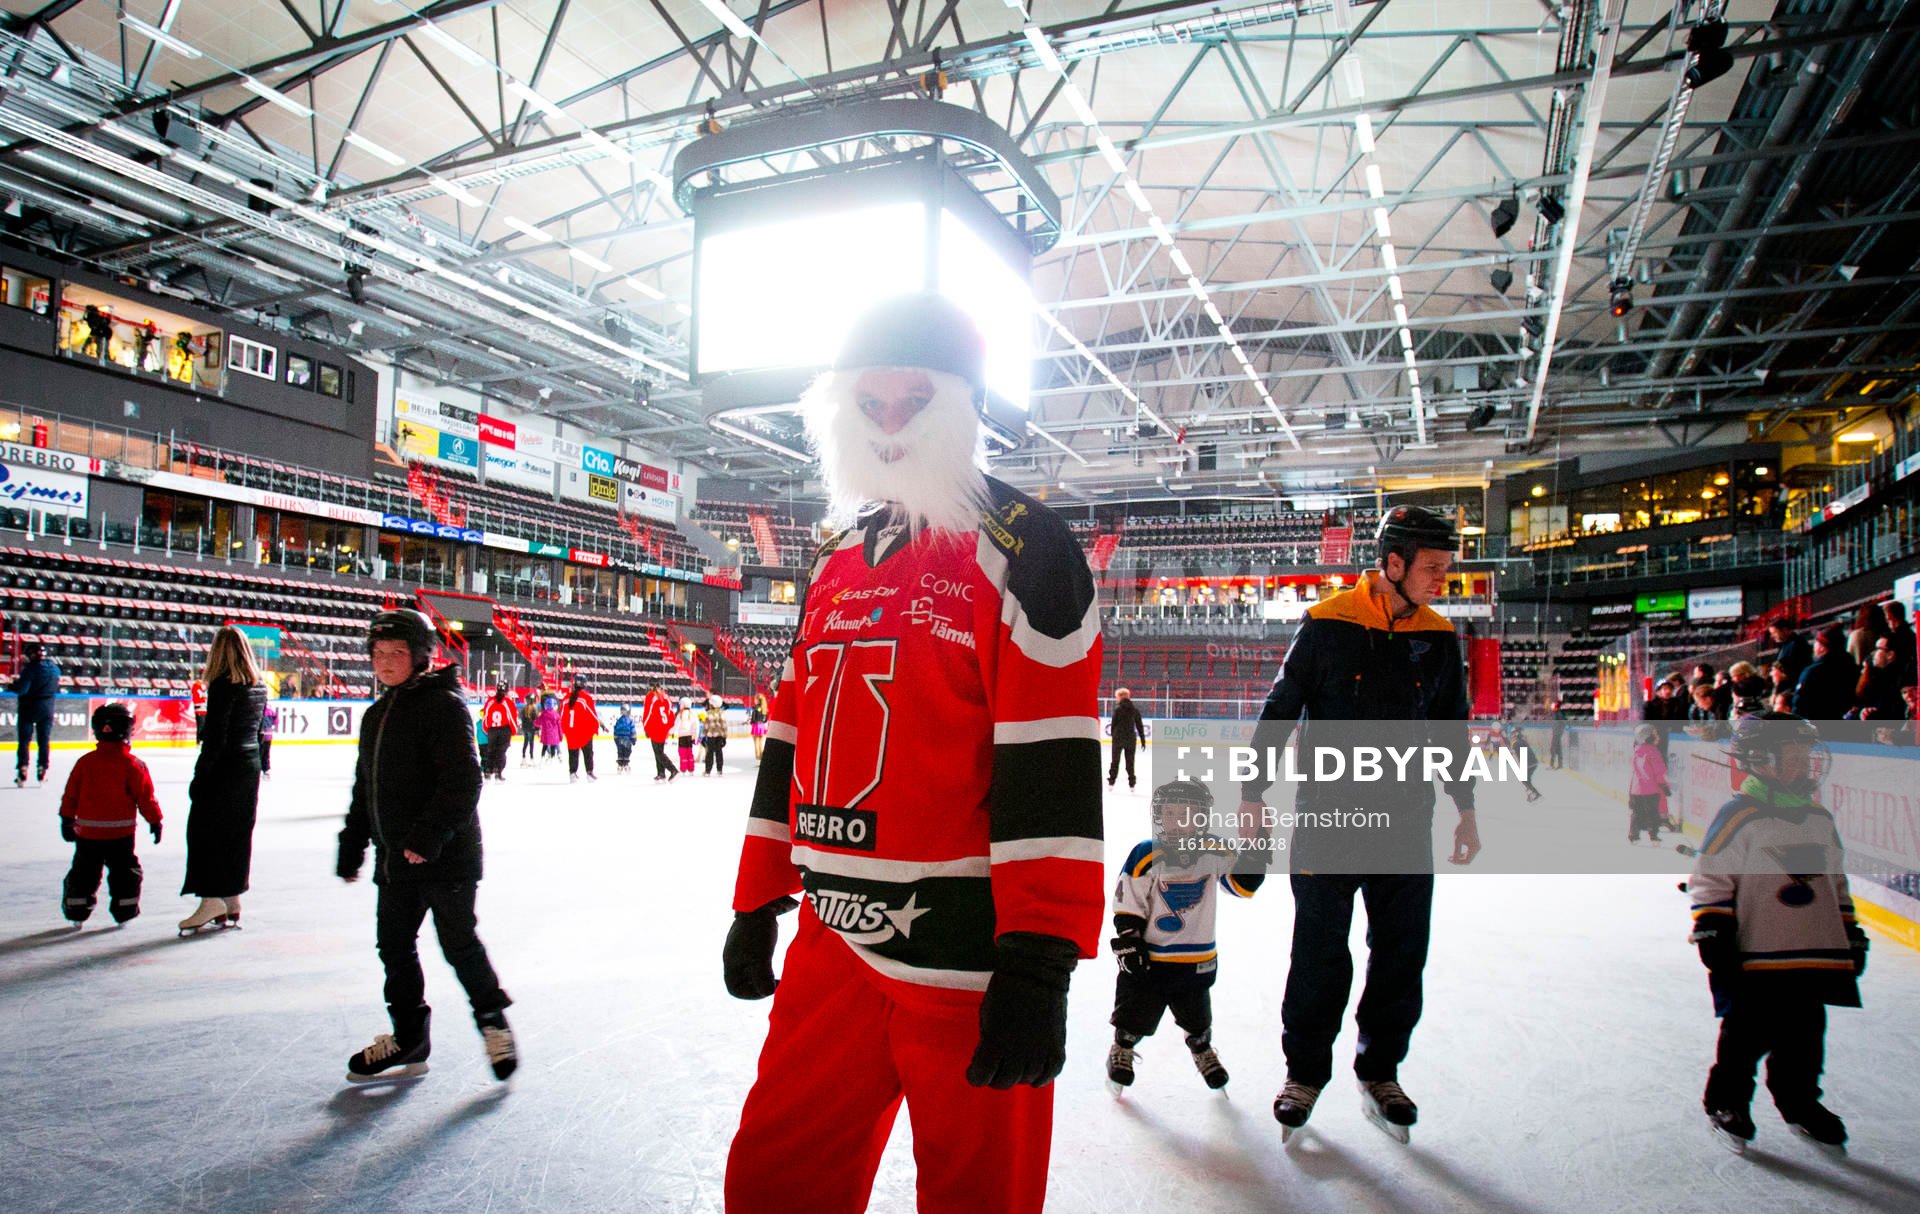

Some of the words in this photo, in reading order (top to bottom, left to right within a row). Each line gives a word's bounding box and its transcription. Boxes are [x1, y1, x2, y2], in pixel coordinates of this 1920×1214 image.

[263, 495, 306, 513] BEHRN
[840, 586, 900, 600] EASTON
[920, 572, 975, 602] CONC
[138, 688, 160, 697] EXACT
[169, 689, 191, 697] EXACT
[1164, 723, 1208, 740] DANFO
[796, 811, 867, 843] REBRO
